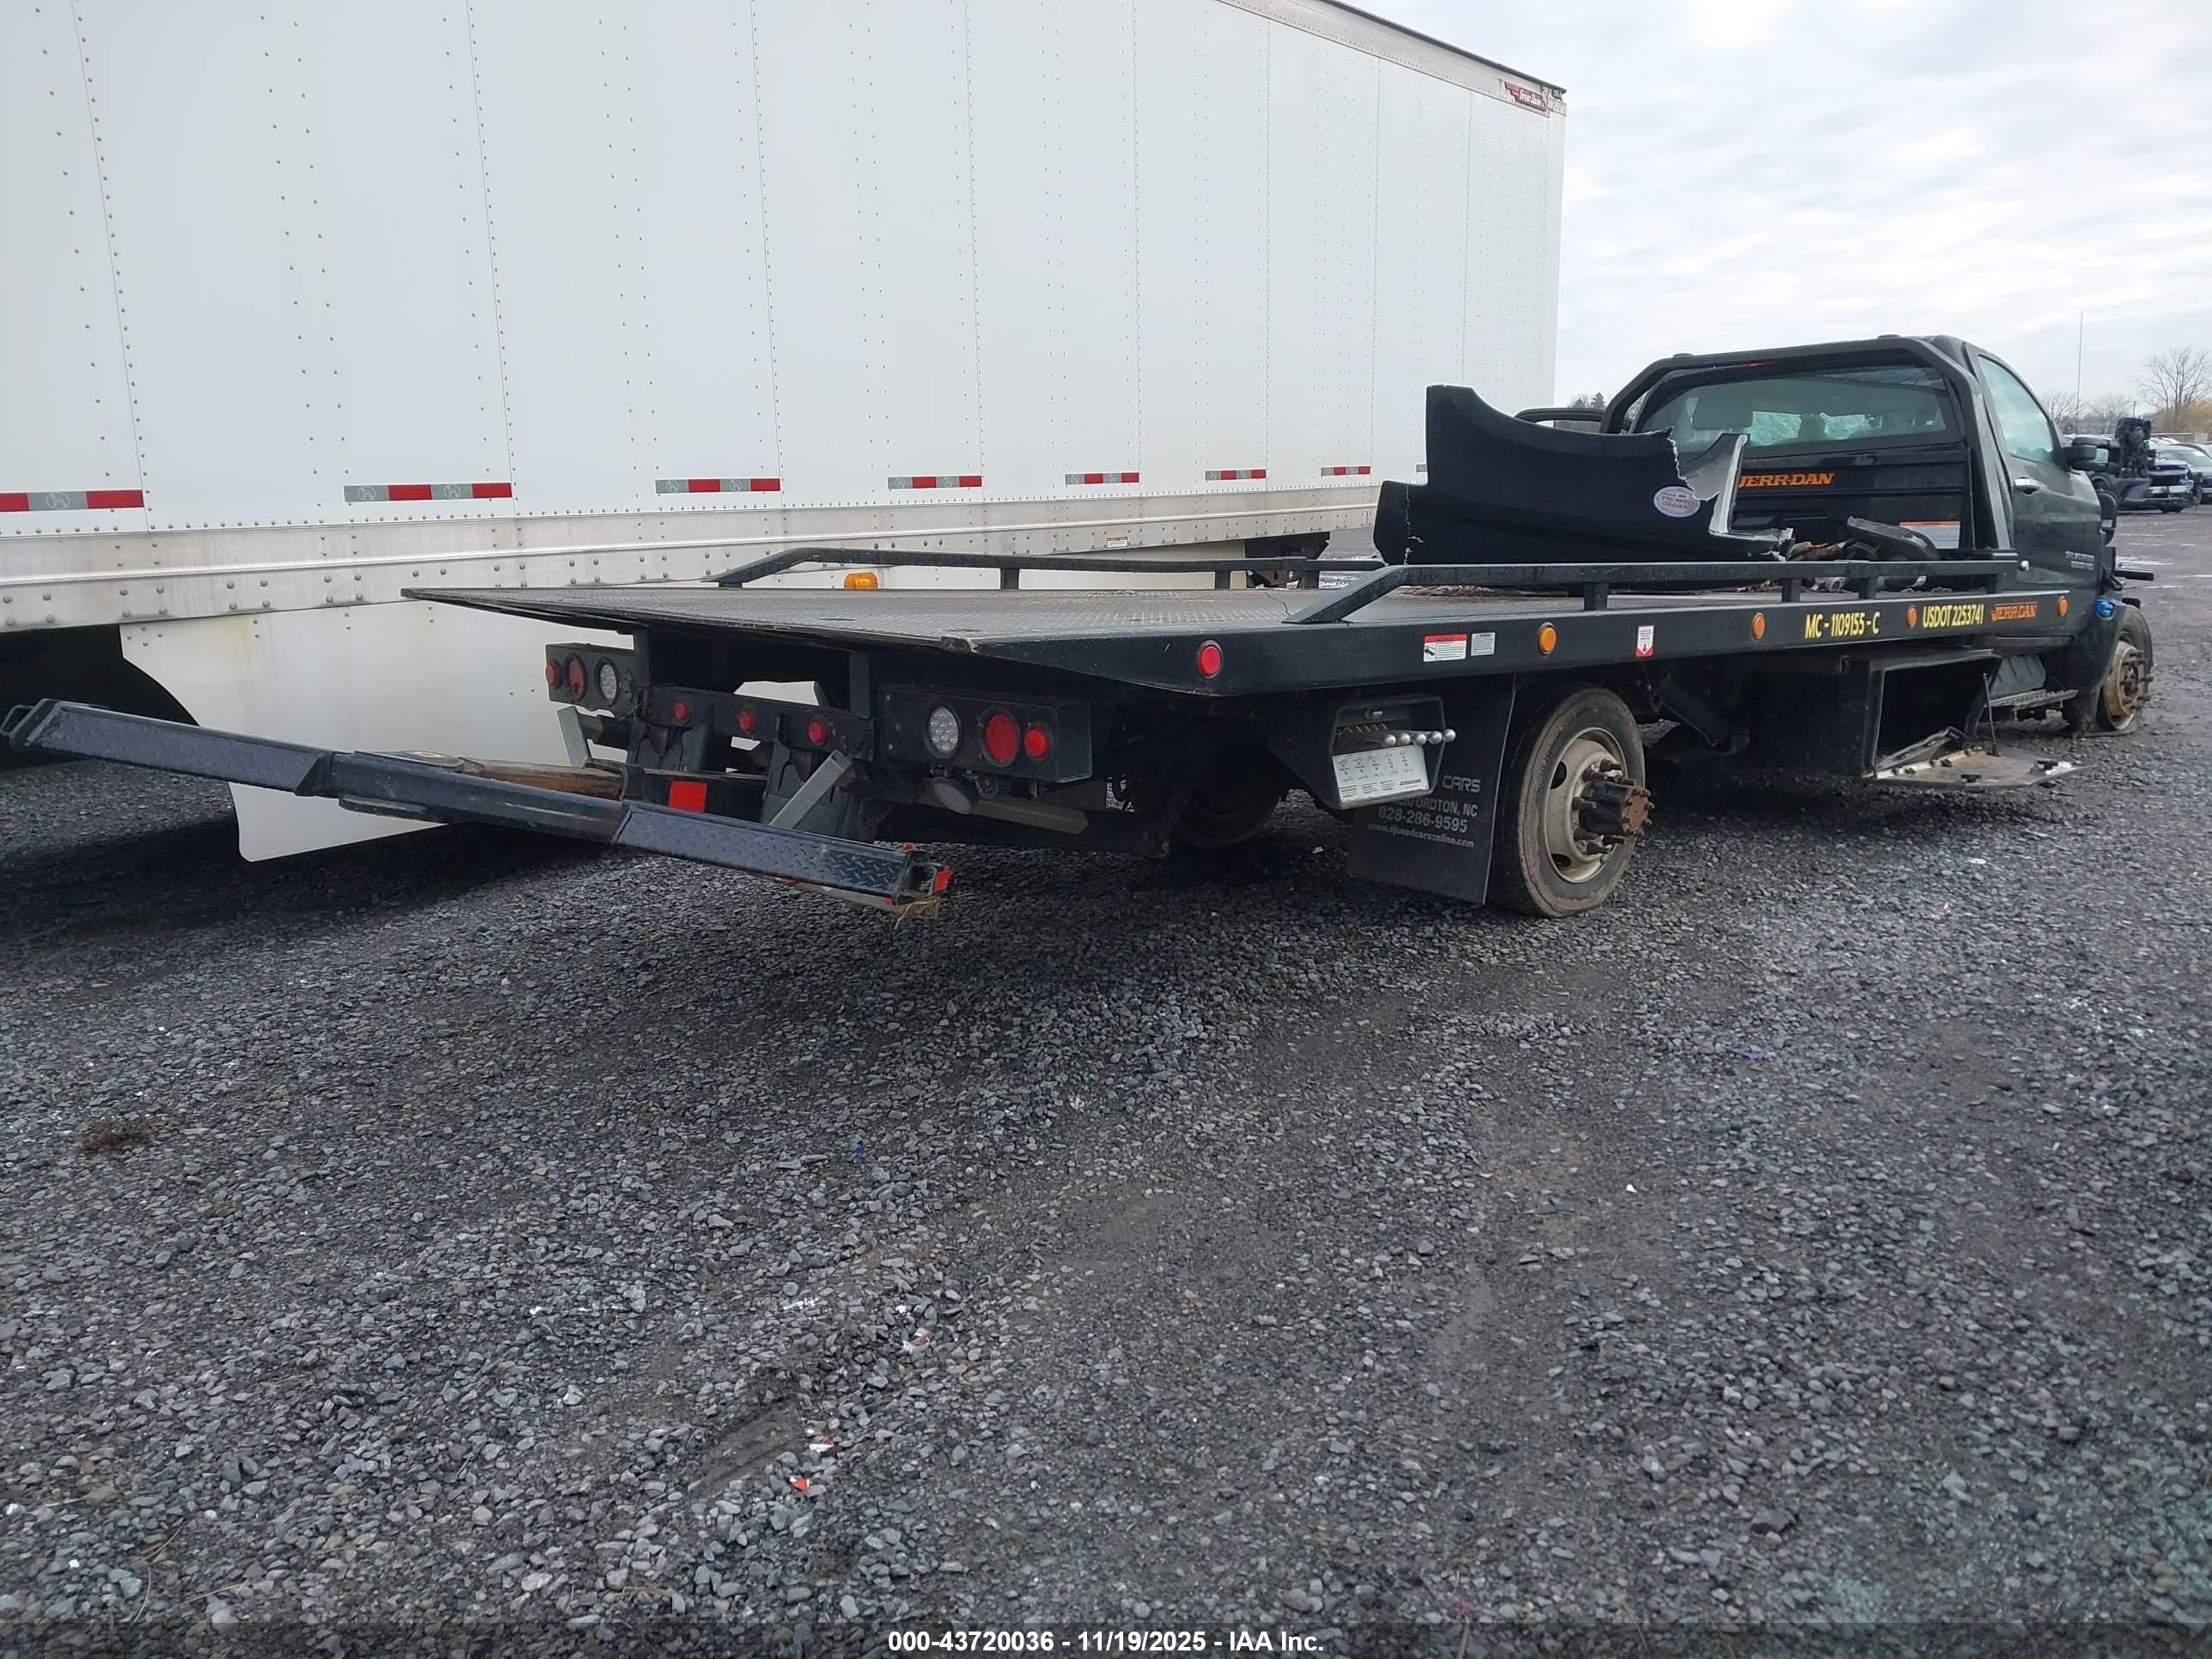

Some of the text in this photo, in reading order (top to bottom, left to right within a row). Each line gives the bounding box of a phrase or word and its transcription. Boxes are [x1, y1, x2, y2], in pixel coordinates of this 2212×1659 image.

[1923, 605, 1984, 628] USDOT 2253741
[1443, 775, 1481, 793] CARS
[1378, 806, 1468, 833] 828-286-9595
[1463, 803, 1478, 817] NC
